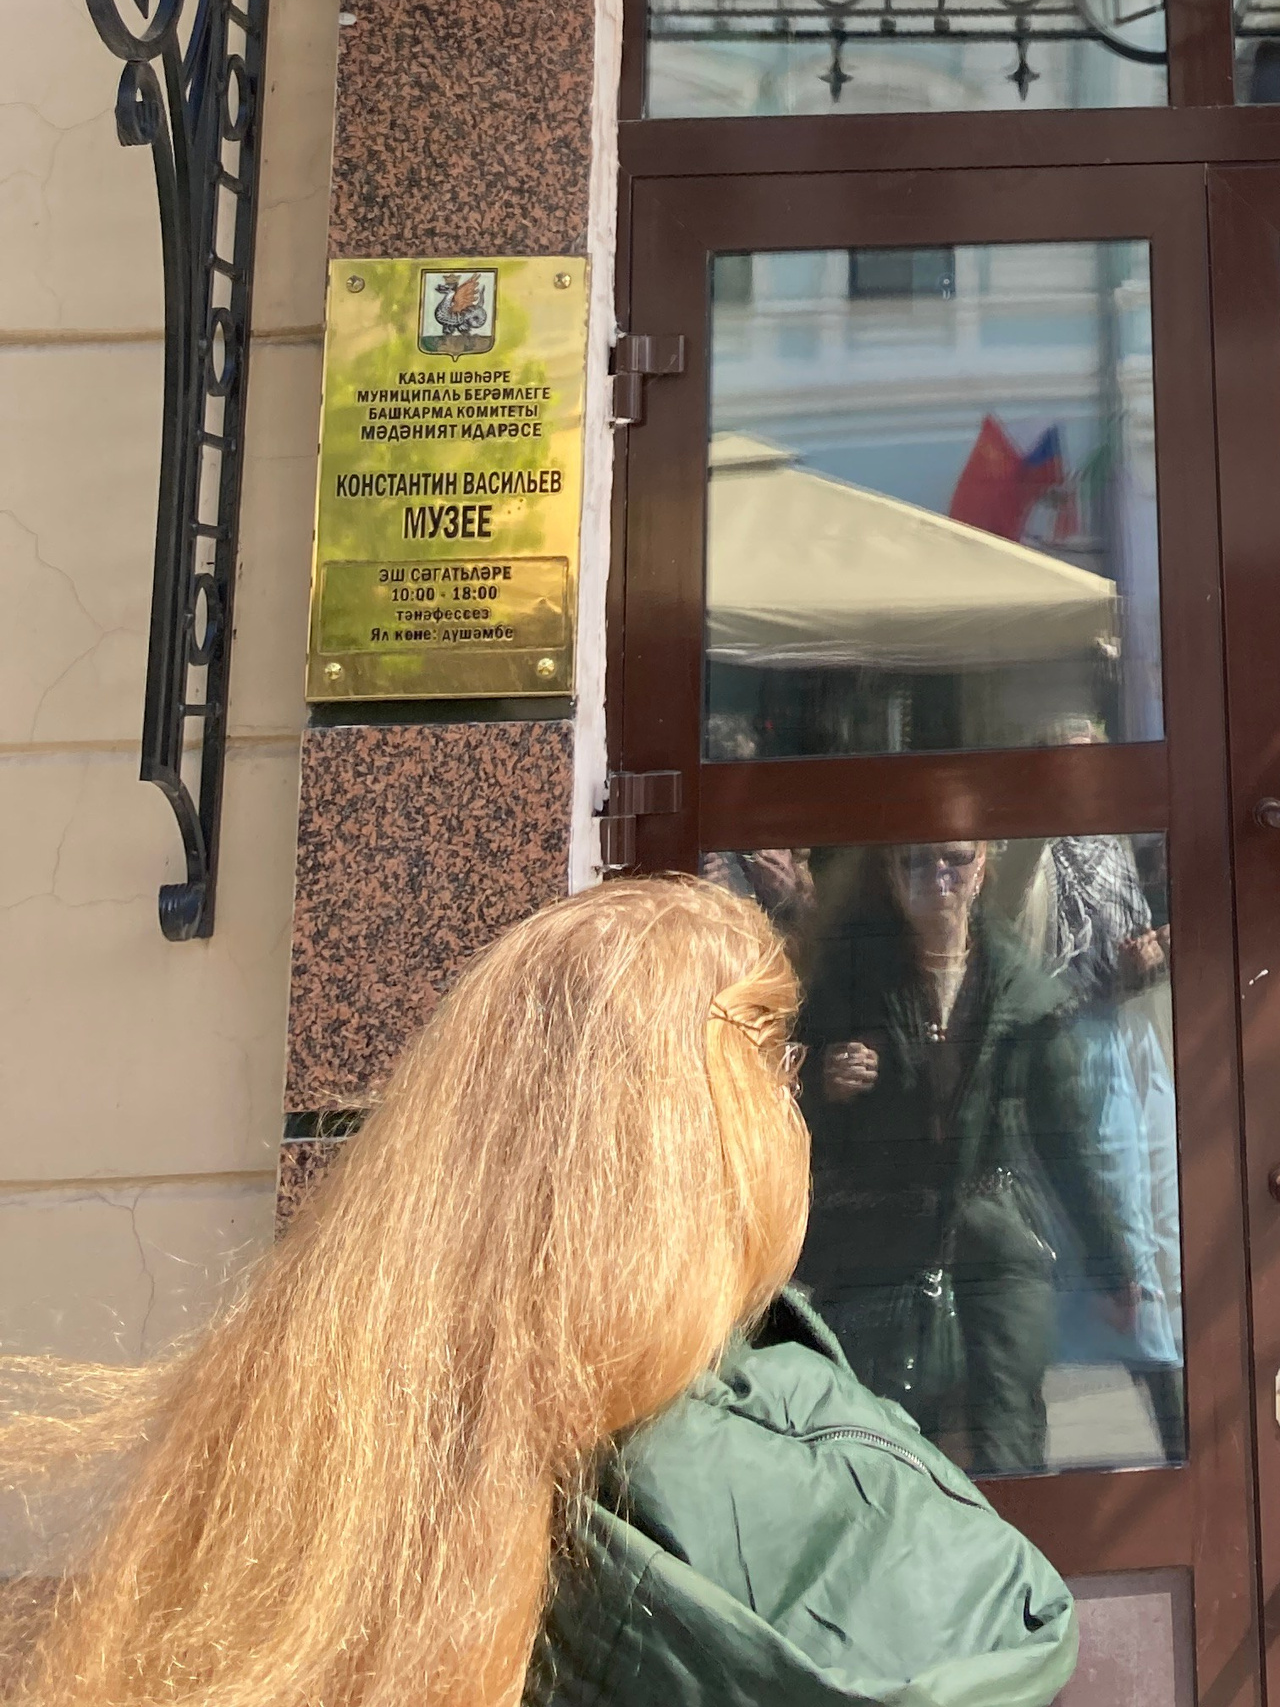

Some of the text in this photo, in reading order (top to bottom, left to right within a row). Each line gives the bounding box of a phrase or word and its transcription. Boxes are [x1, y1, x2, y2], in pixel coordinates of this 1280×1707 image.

[398, 372, 445, 385] КАЗАН
[357, 387, 550, 404] МУНИЦИПАЛЬ БЕРӘМЛЕГЕ
[369, 405, 538, 420] БАШКАРМА КОМИТЕТЫ
[361, 422, 541, 442] МӘДӘНИЯТ ИДАРӘСЕ
[337, 470, 562, 498] КОНСТАНТИН ВАСИЛЬЕВ
[403, 505, 492, 539] МУЗЕЕ
[379, 566, 512, 583] ЭШ СӘГАТЬЛӘРЕ
[392, 588, 435, 601] 10:00
[453, 586, 497, 600] 18:00
[396, 609, 490, 623] тәнәфессез
[371, 624, 513, 643] Ял көне: дүшәмбе
